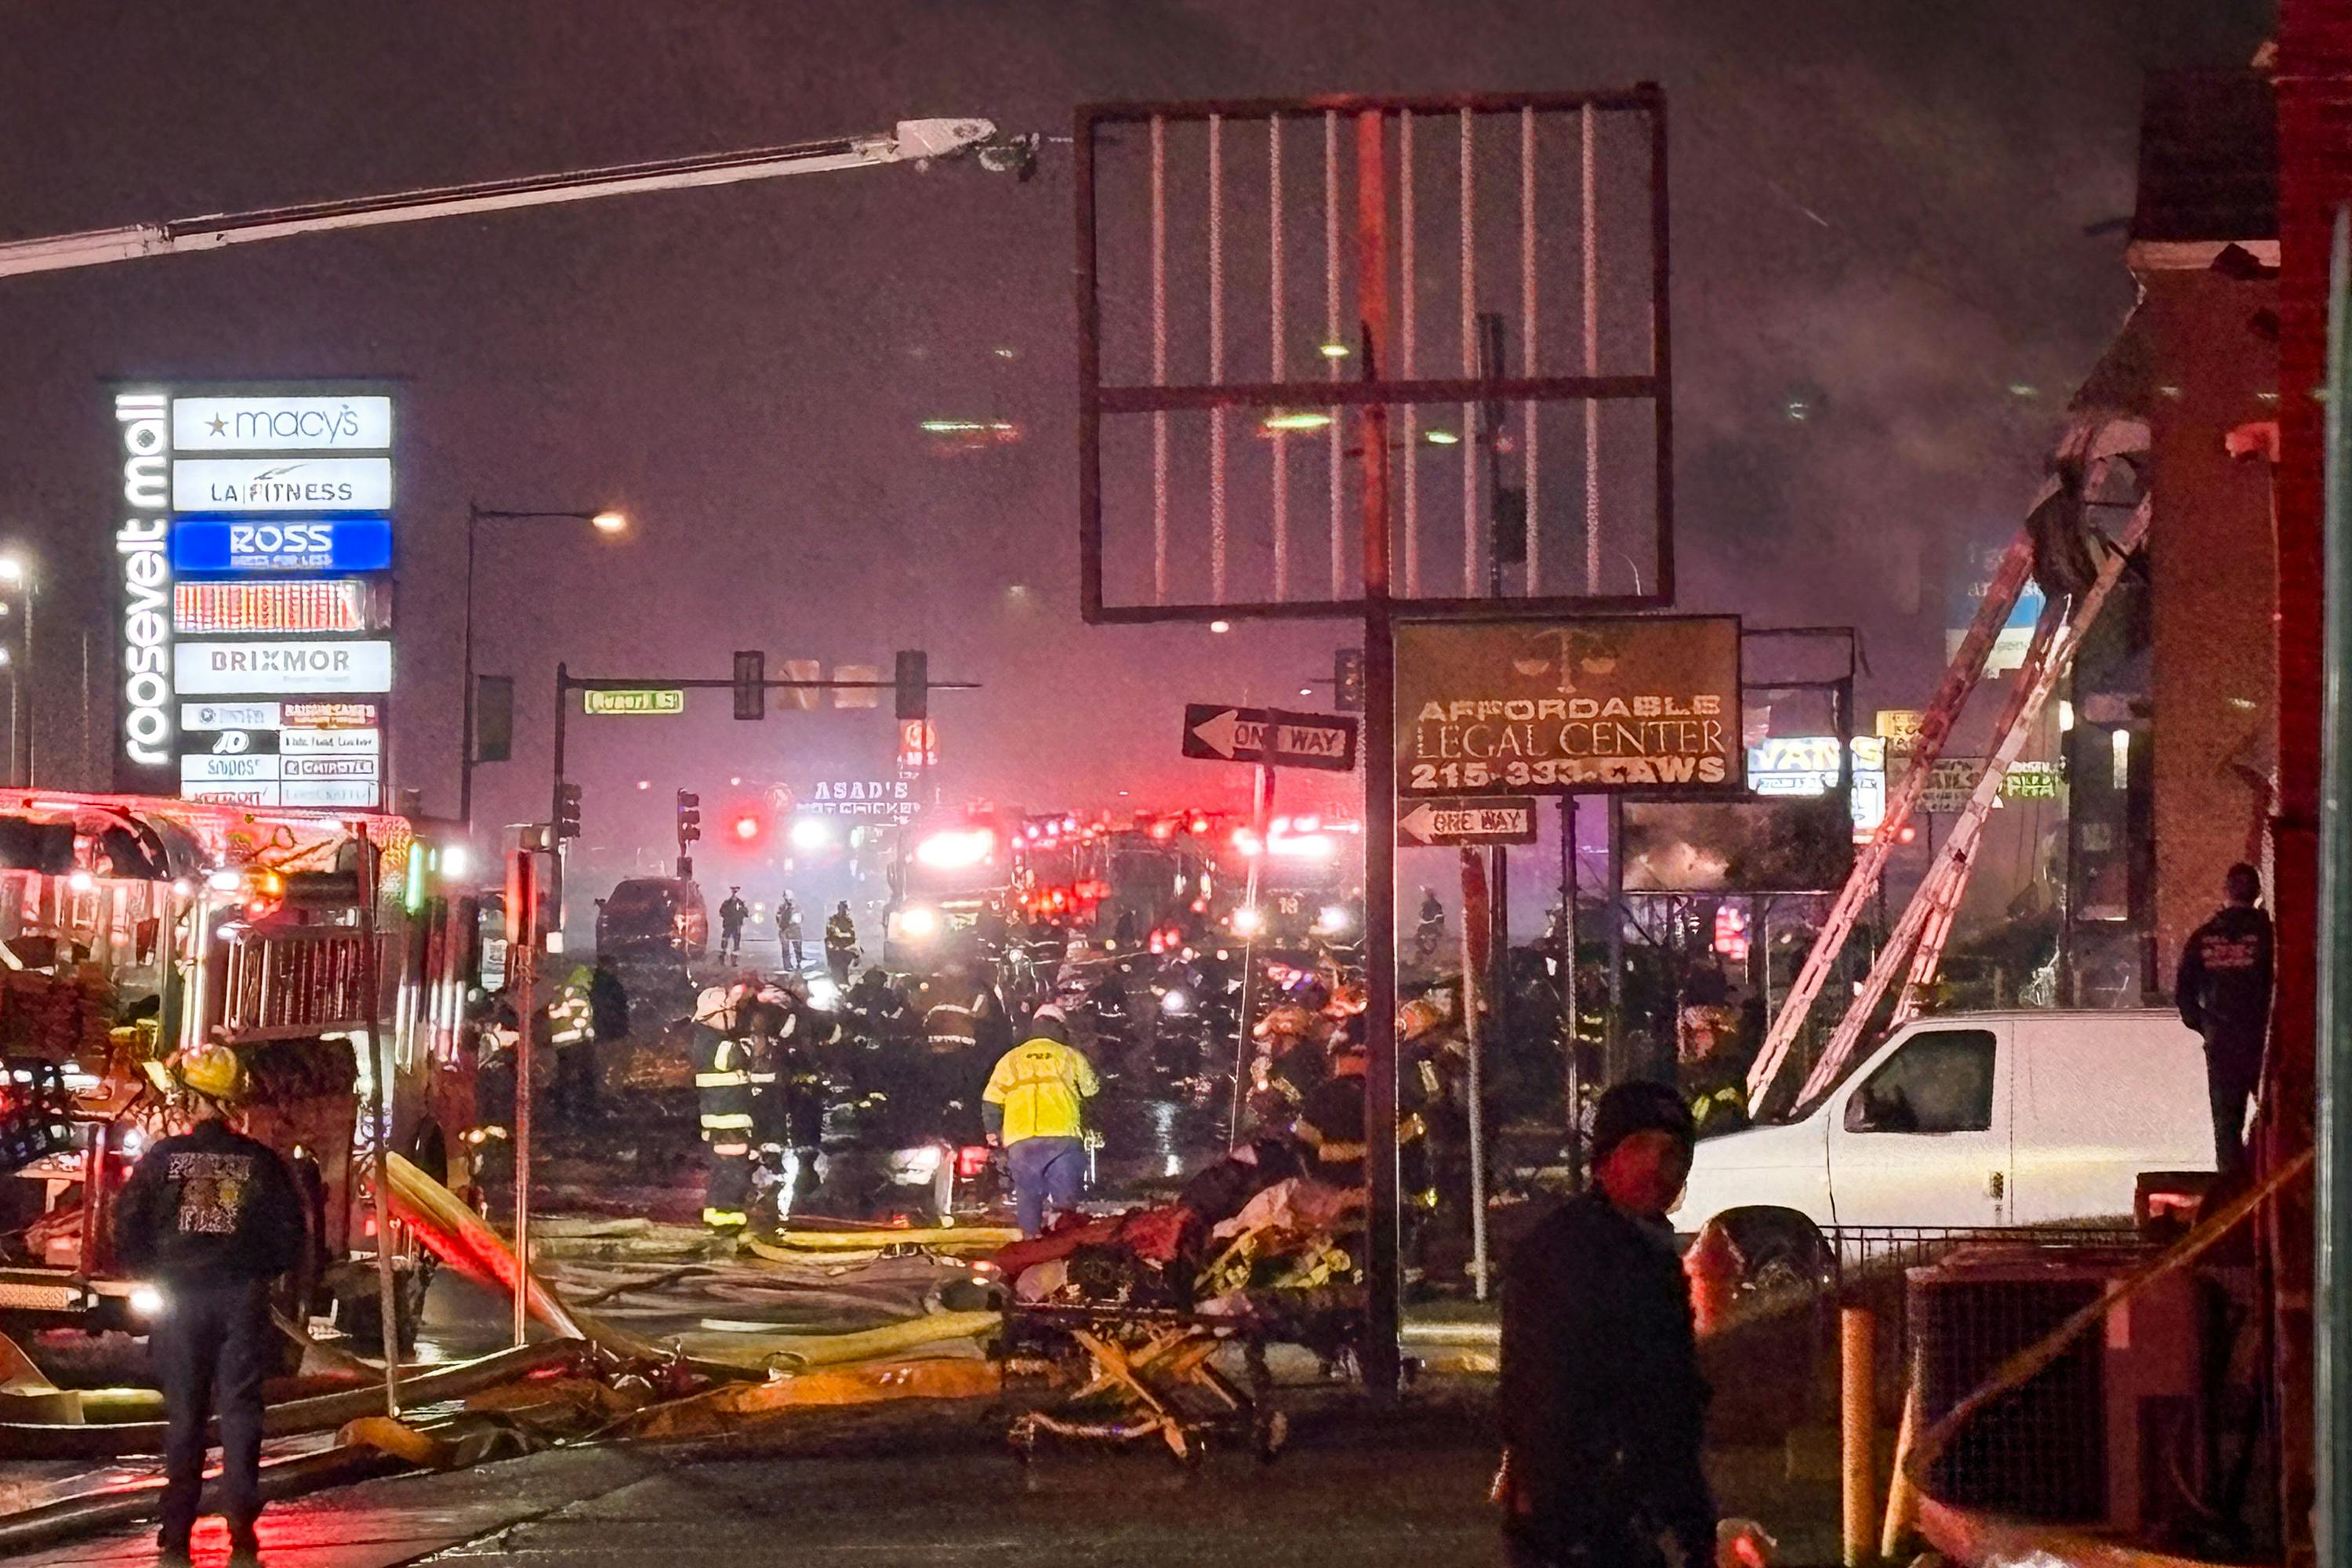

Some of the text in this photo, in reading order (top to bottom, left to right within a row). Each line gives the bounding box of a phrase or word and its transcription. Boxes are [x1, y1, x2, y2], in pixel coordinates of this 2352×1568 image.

[237, 404, 358, 444] macy's
[211, 483, 352, 502] LA FITNESS
[230, 524, 333, 554] ROSS
[116, 394, 167, 764] roosevelt mall
[212, 650, 350, 672] BRIXMOR
[1417, 695, 1721, 722] AFFORDABLE
[1234, 724, 1339, 752] ON WAY
[1417, 719, 1726, 759] LEGAL CENTER
[815, 782, 908, 800] ASAD'S
[1434, 811, 1521, 832] ONE WAY
